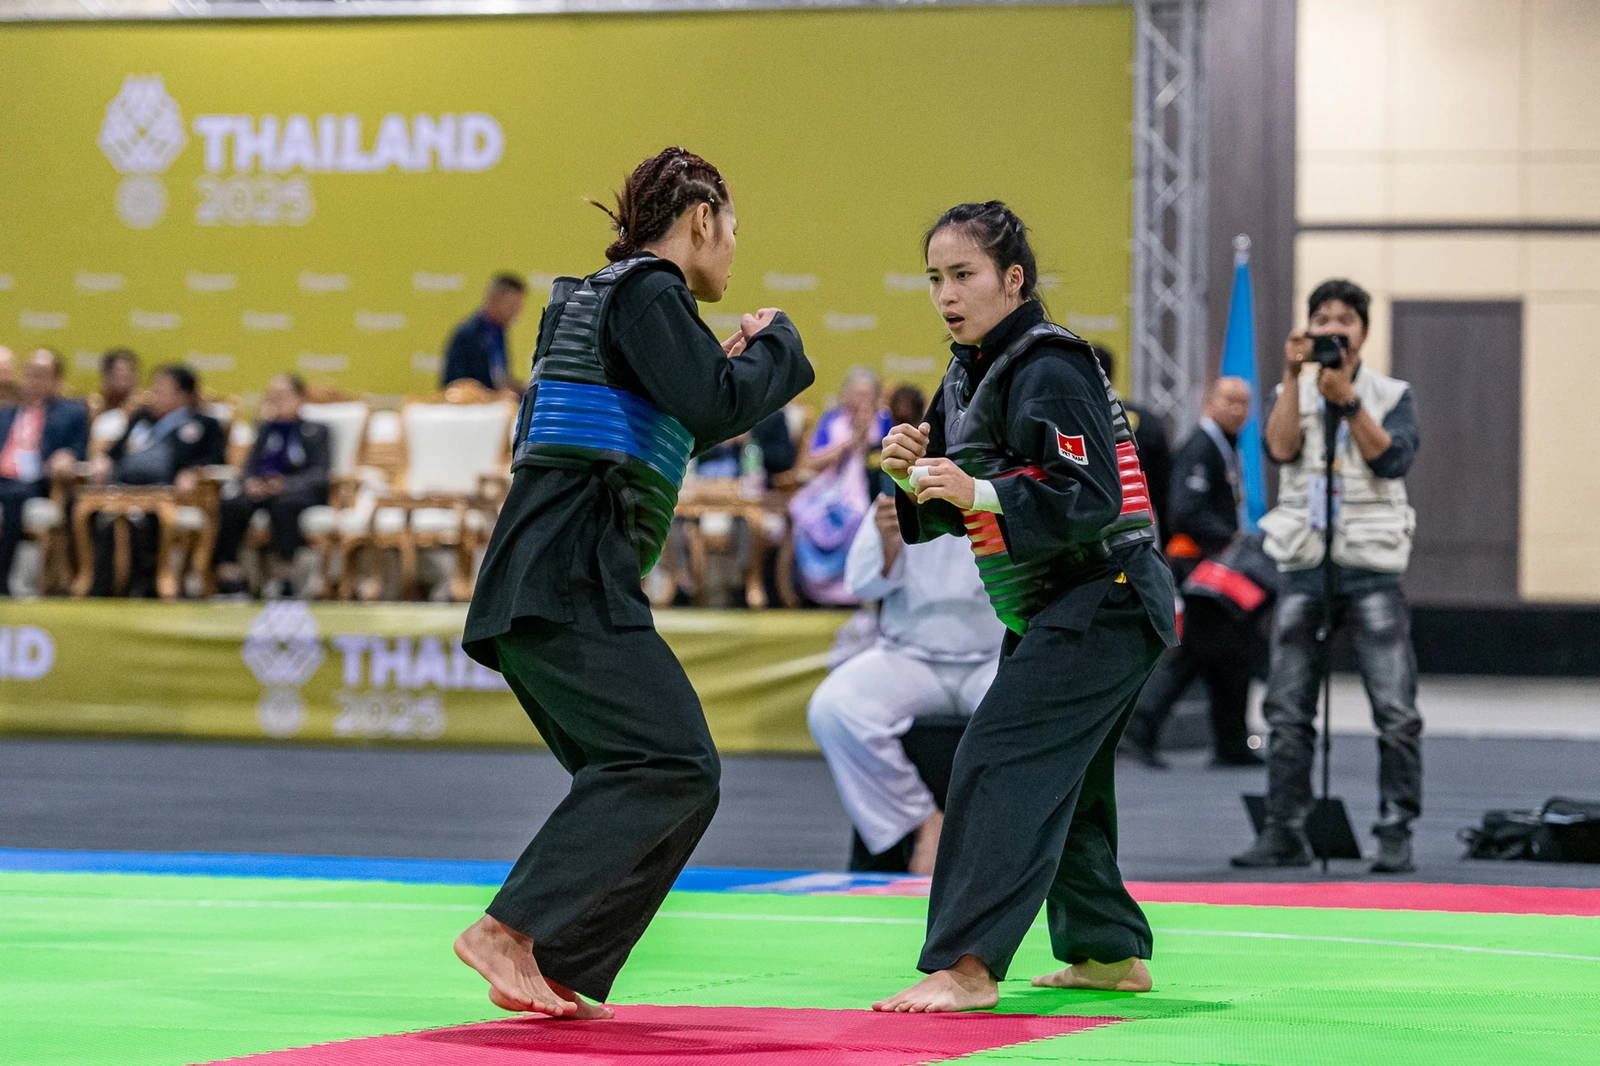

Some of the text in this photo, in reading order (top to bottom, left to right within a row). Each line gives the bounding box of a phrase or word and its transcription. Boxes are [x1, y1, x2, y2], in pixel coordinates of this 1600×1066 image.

[195, 113, 504, 171] THAILAND
[195, 177, 313, 226] 2025
[333, 691, 446, 738] 2025
